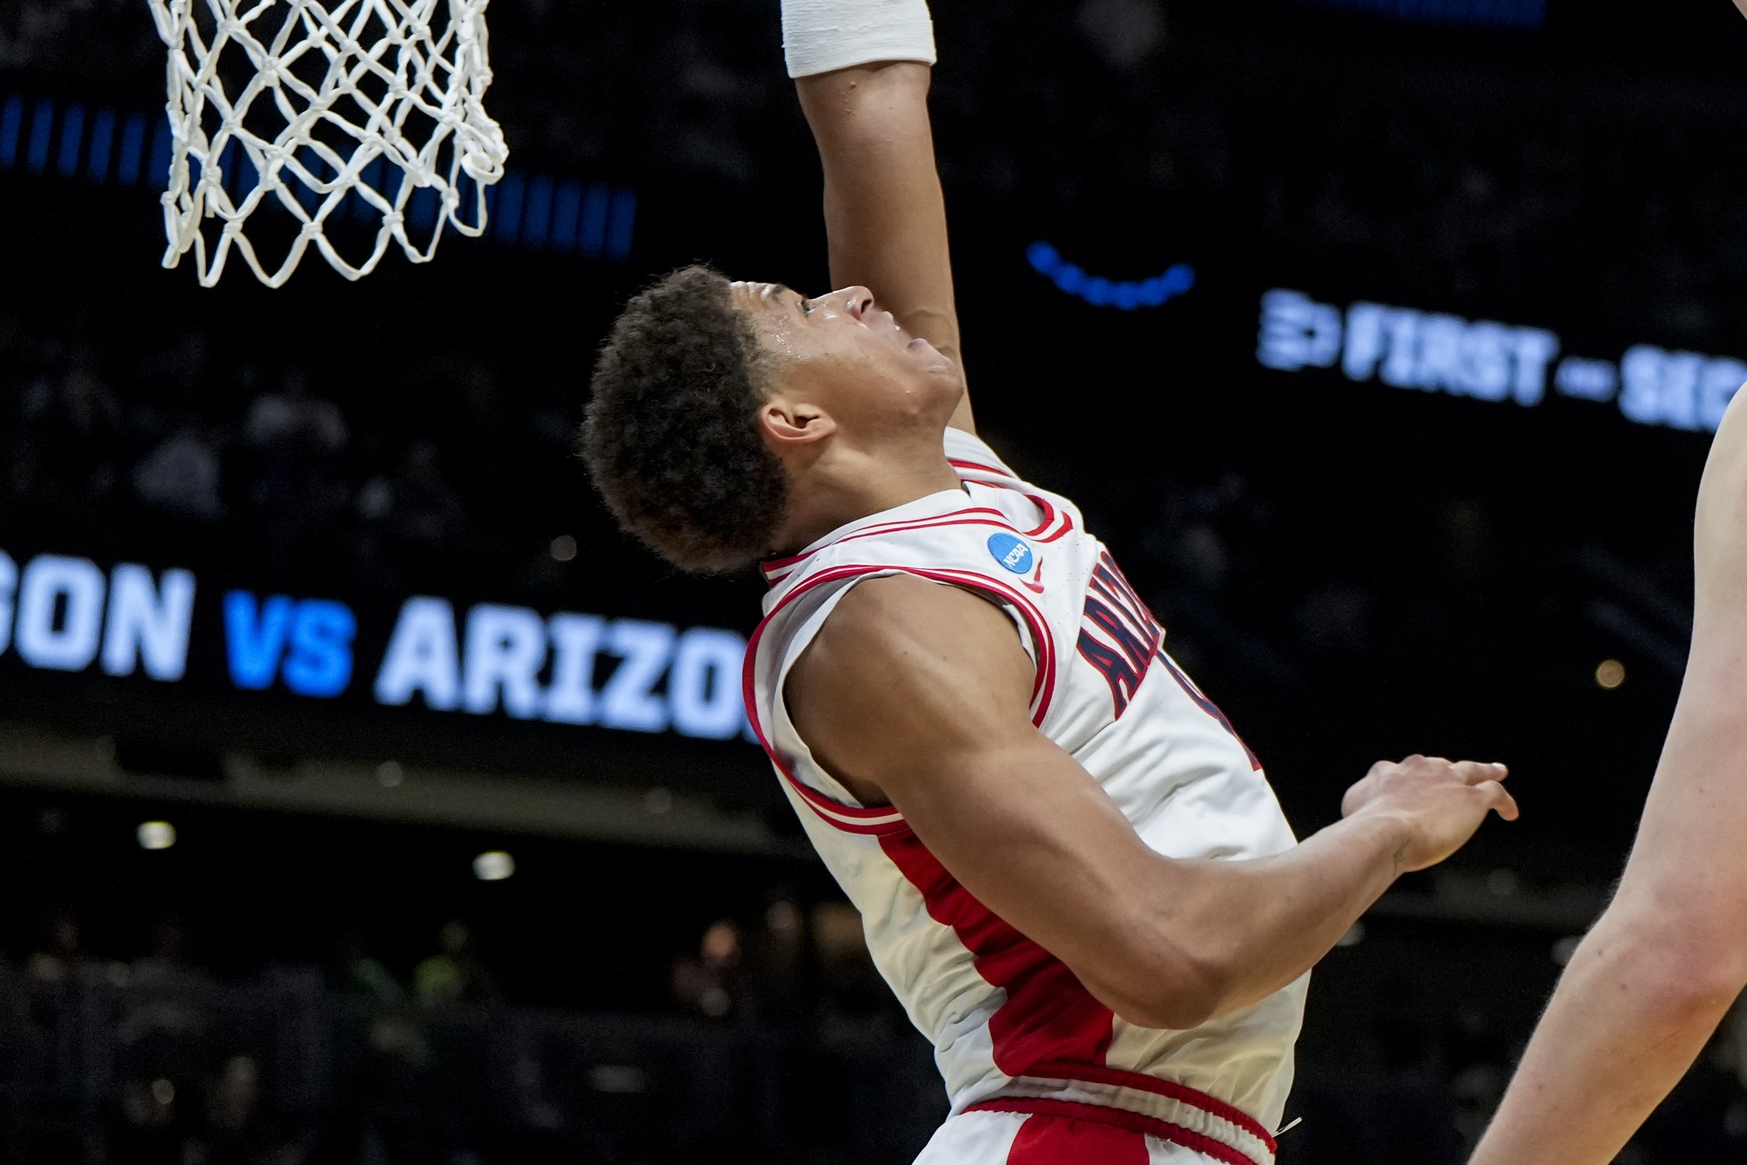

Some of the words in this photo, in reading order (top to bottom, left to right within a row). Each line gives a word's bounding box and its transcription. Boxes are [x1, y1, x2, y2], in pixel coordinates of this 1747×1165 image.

[1342, 301, 1561, 407] FIRST
[1003, 542, 1029, 569] NCAA
[0, 549, 197, 683] ON
[222, 588, 358, 700] VS
[373, 594, 763, 745] ARIZO
